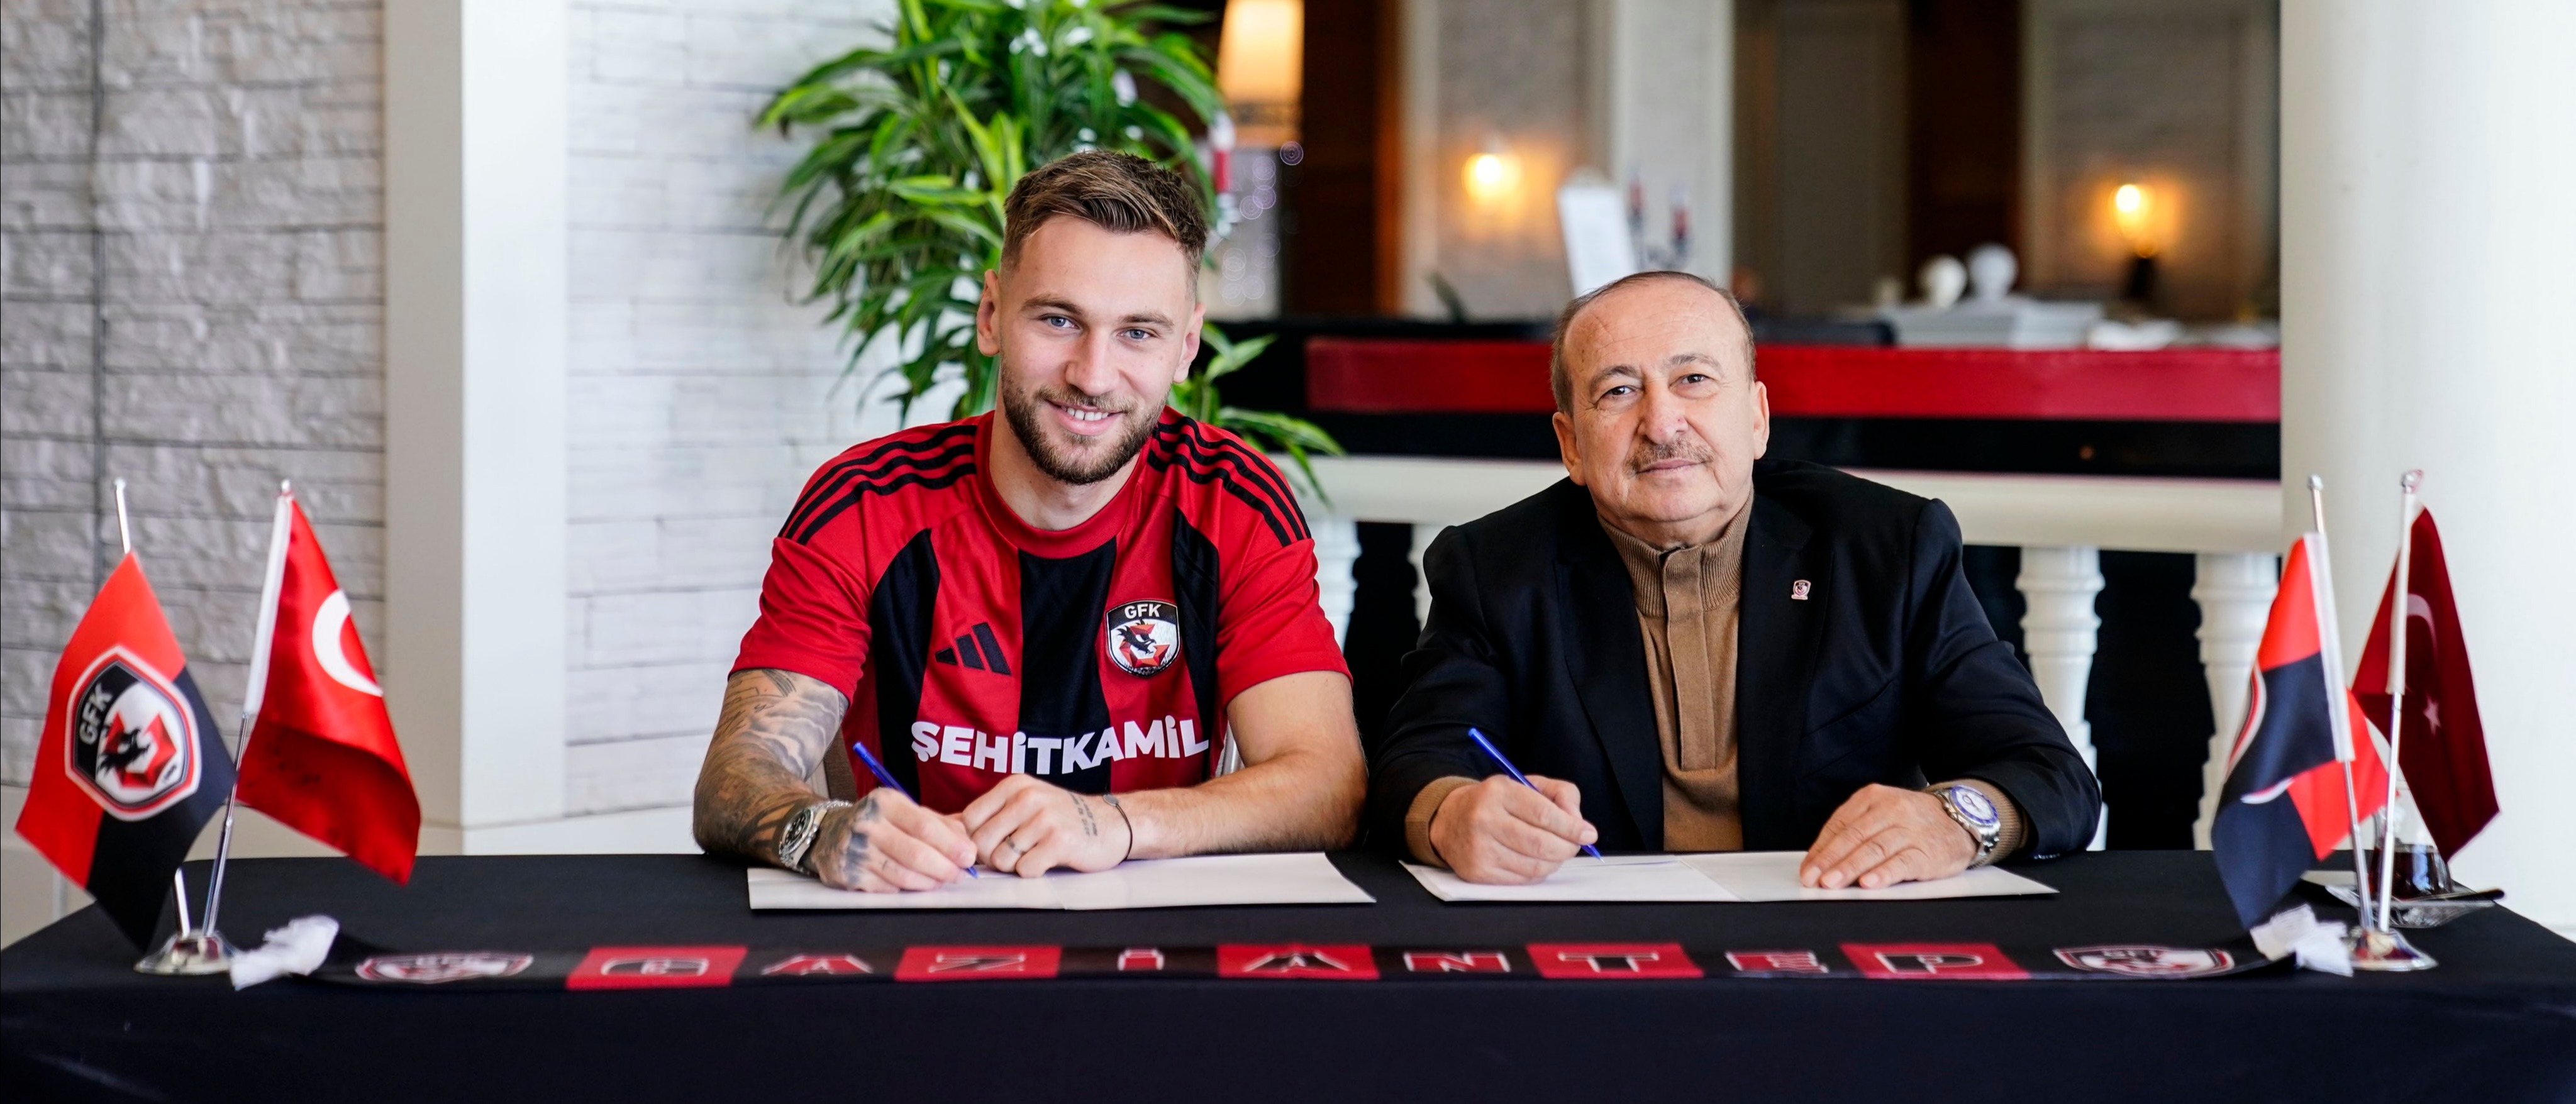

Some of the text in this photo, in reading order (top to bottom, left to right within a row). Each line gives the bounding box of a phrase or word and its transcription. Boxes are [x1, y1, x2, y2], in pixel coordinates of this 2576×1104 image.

[1124, 604, 1162, 619] GFK
[79, 683, 114, 745] GFK
[911, 715, 1209, 775] ŞEHİTKAMİL
